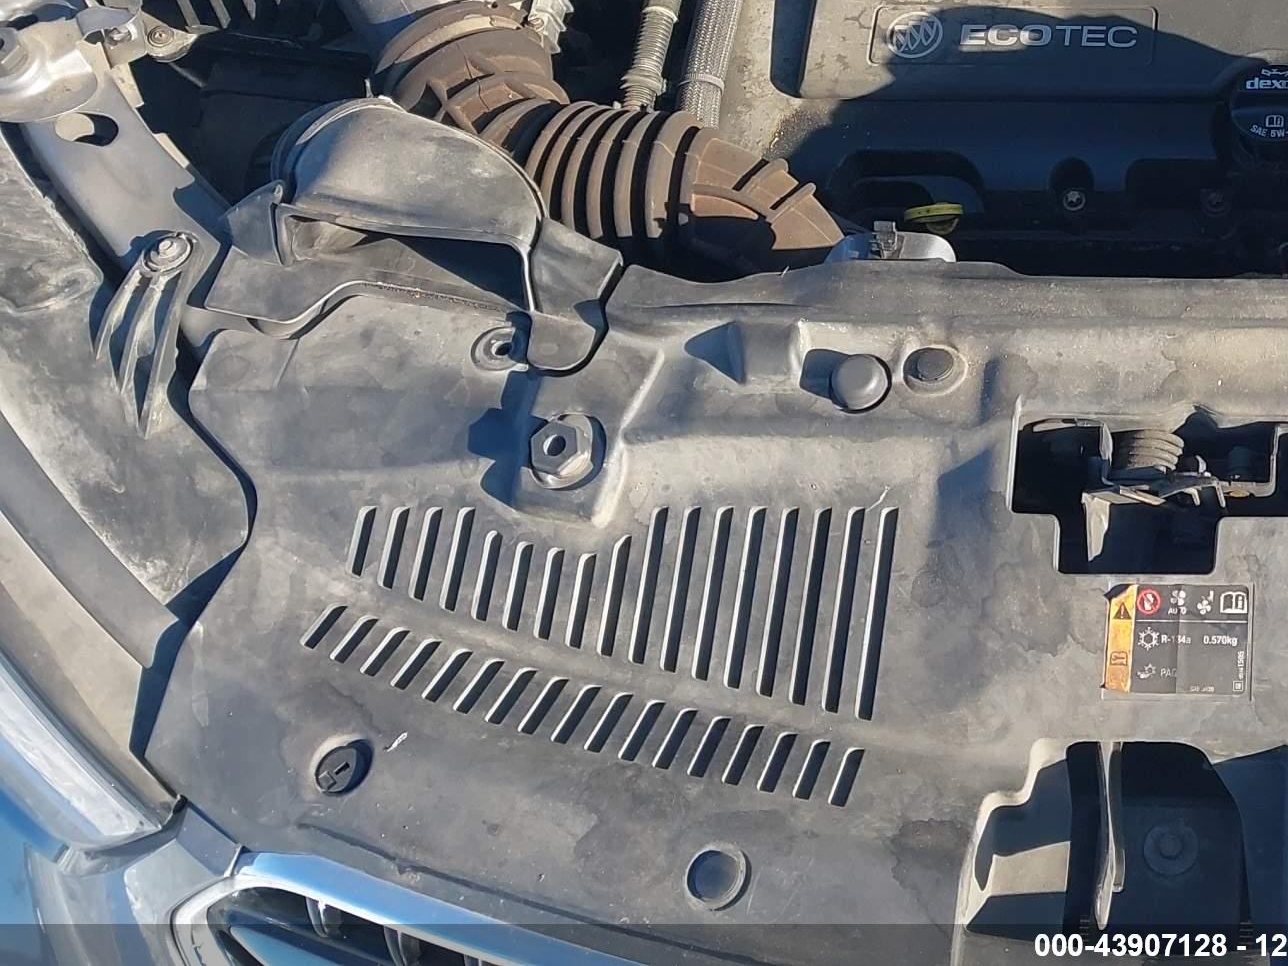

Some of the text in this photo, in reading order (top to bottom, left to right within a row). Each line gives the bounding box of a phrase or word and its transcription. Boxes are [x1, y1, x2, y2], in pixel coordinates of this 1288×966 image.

[959, 24, 1138, 48] ECOTEC
[1250, 124, 1268, 138] SAE
[1161, 635, 1239, 647] R-134a 0.570kg
